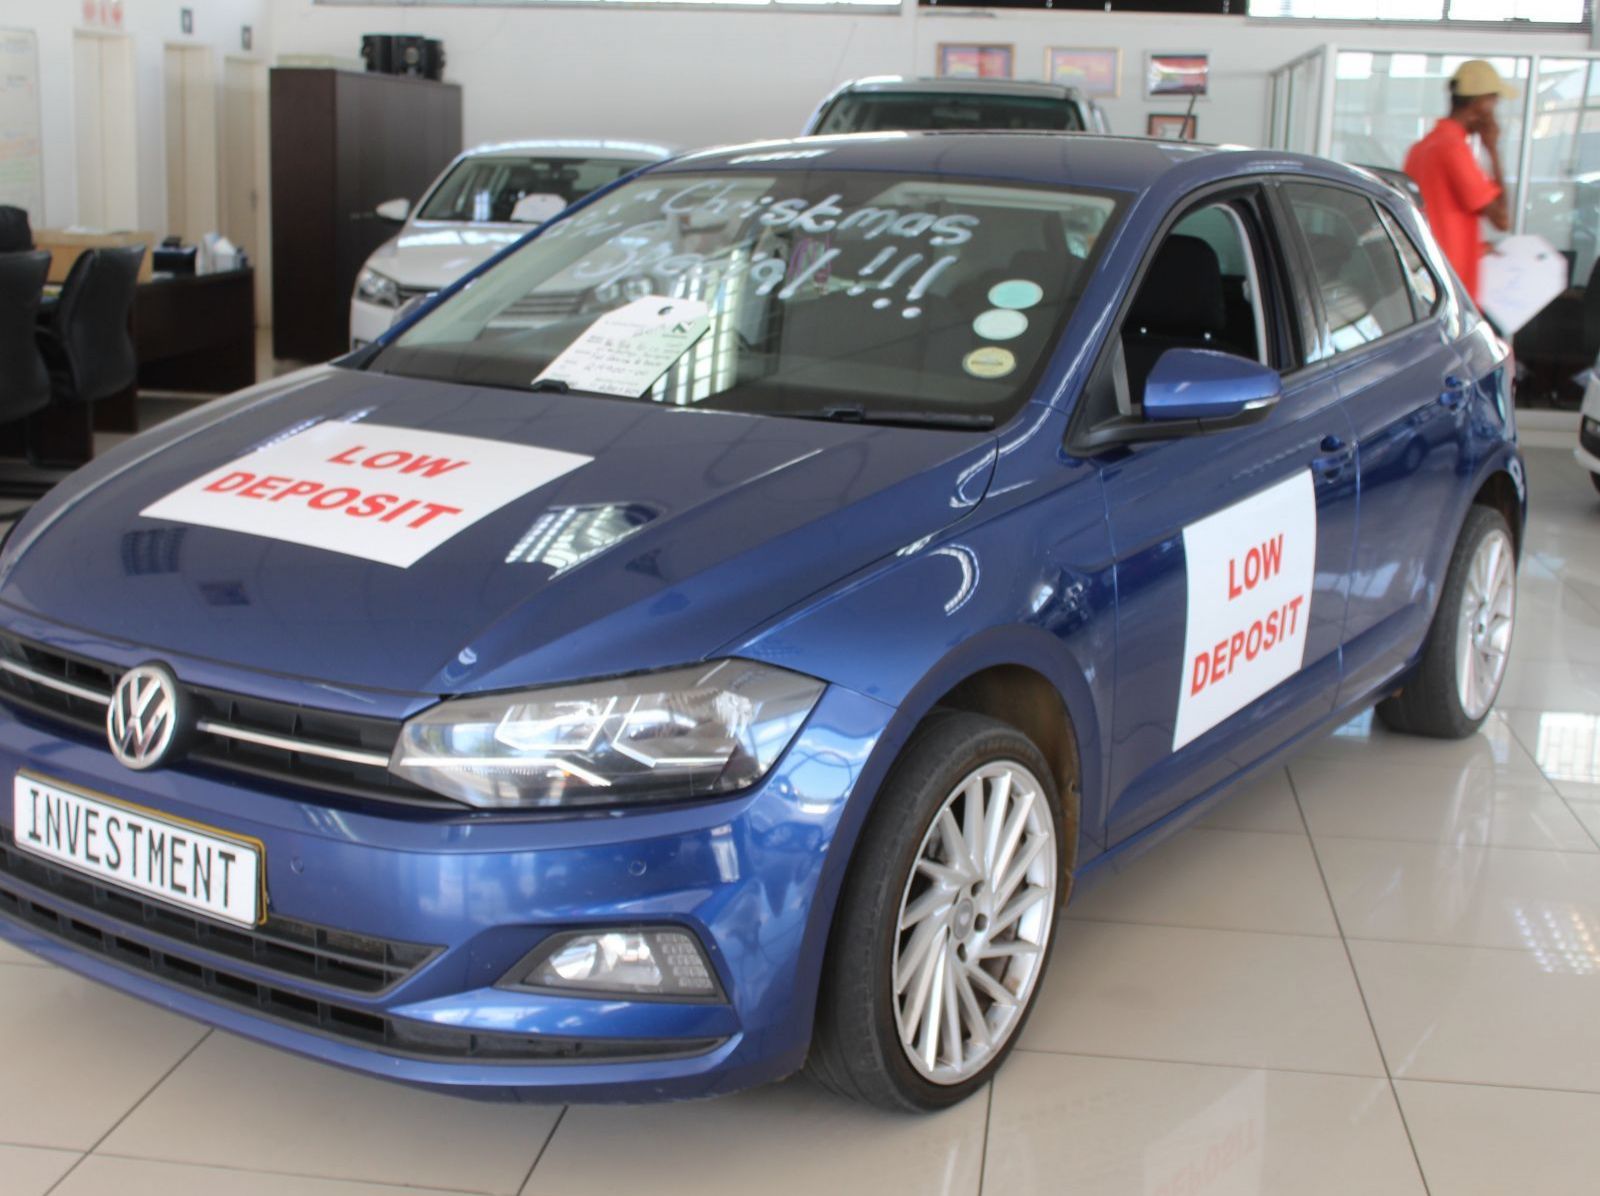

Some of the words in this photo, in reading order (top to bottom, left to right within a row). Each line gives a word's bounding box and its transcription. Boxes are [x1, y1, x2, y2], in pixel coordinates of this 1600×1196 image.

[661, 180, 979, 246] Christmas
[327, 444, 470, 479] LOW
[202, 471, 464, 530] DEPOSIT
[1228, 533, 1284, 602] LOW
[1190, 594, 1304, 697] DEPOSIT
[28, 789, 236, 908] INVESTMENT
